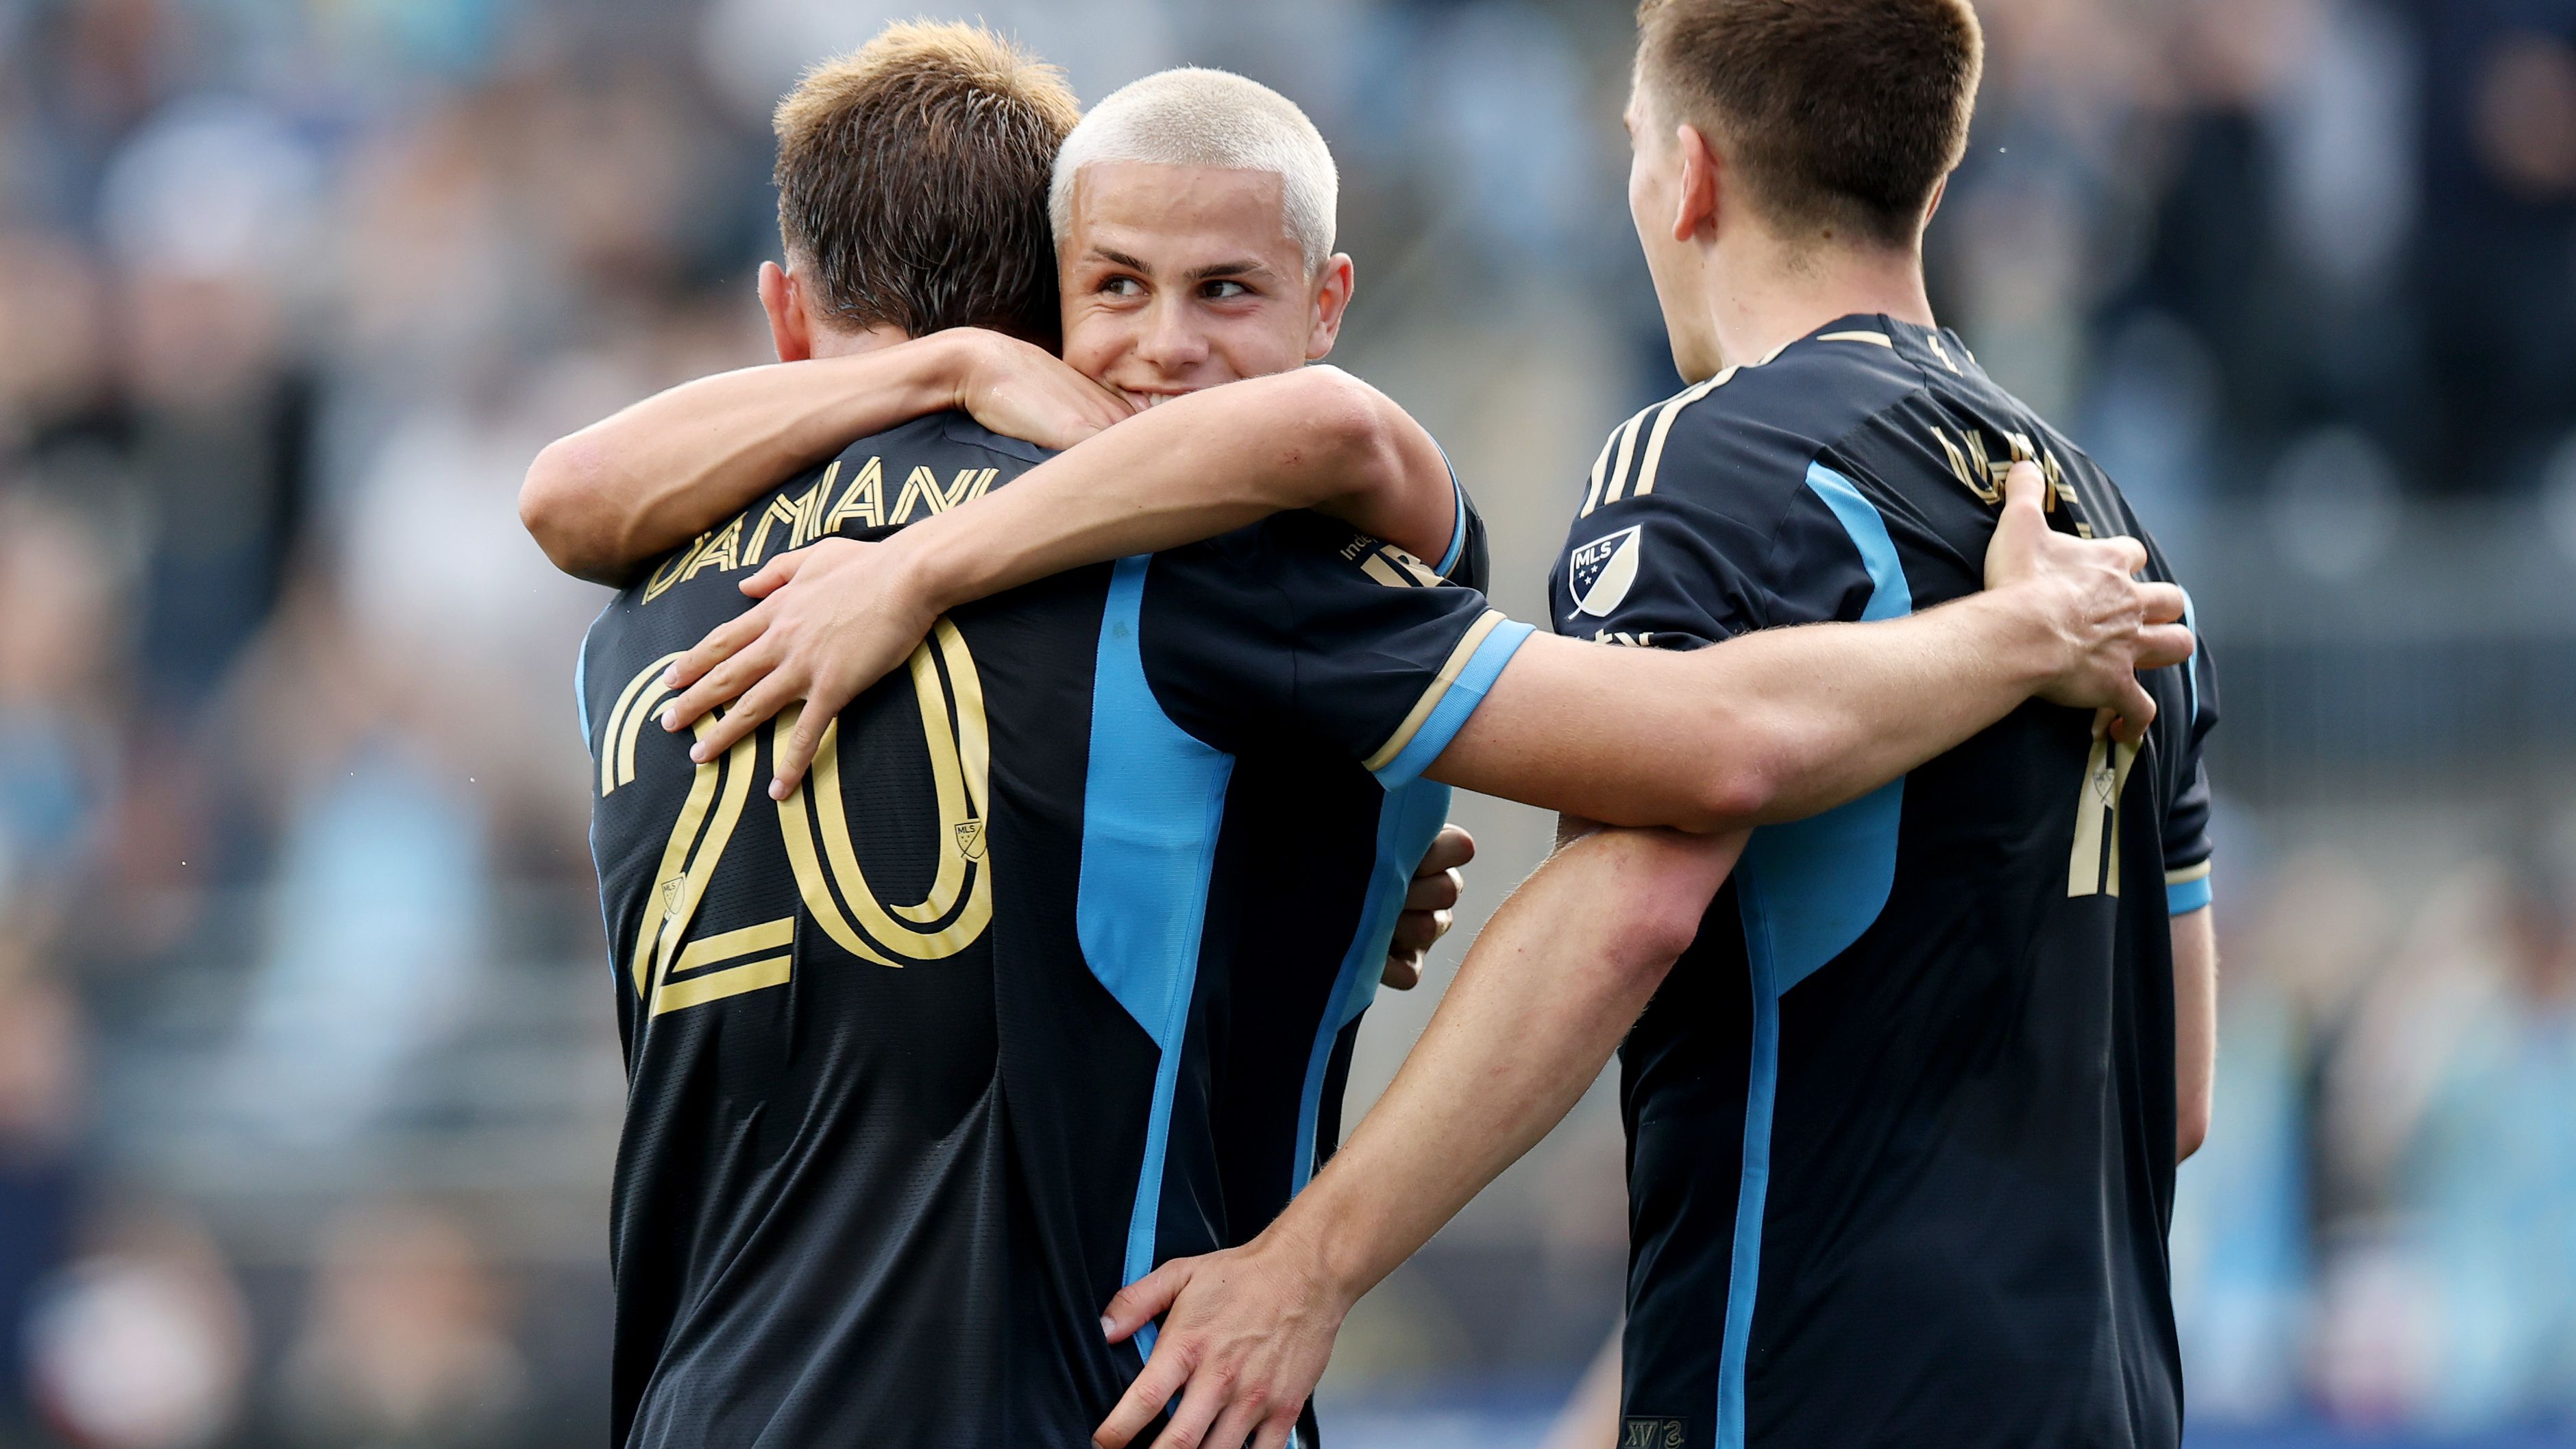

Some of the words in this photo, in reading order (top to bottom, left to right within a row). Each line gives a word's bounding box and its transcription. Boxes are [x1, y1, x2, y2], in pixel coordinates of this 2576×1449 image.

[1576, 541, 1612, 570] MLS
[602, 617, 992, 1023] 20
[958, 825, 975, 834] MLS
